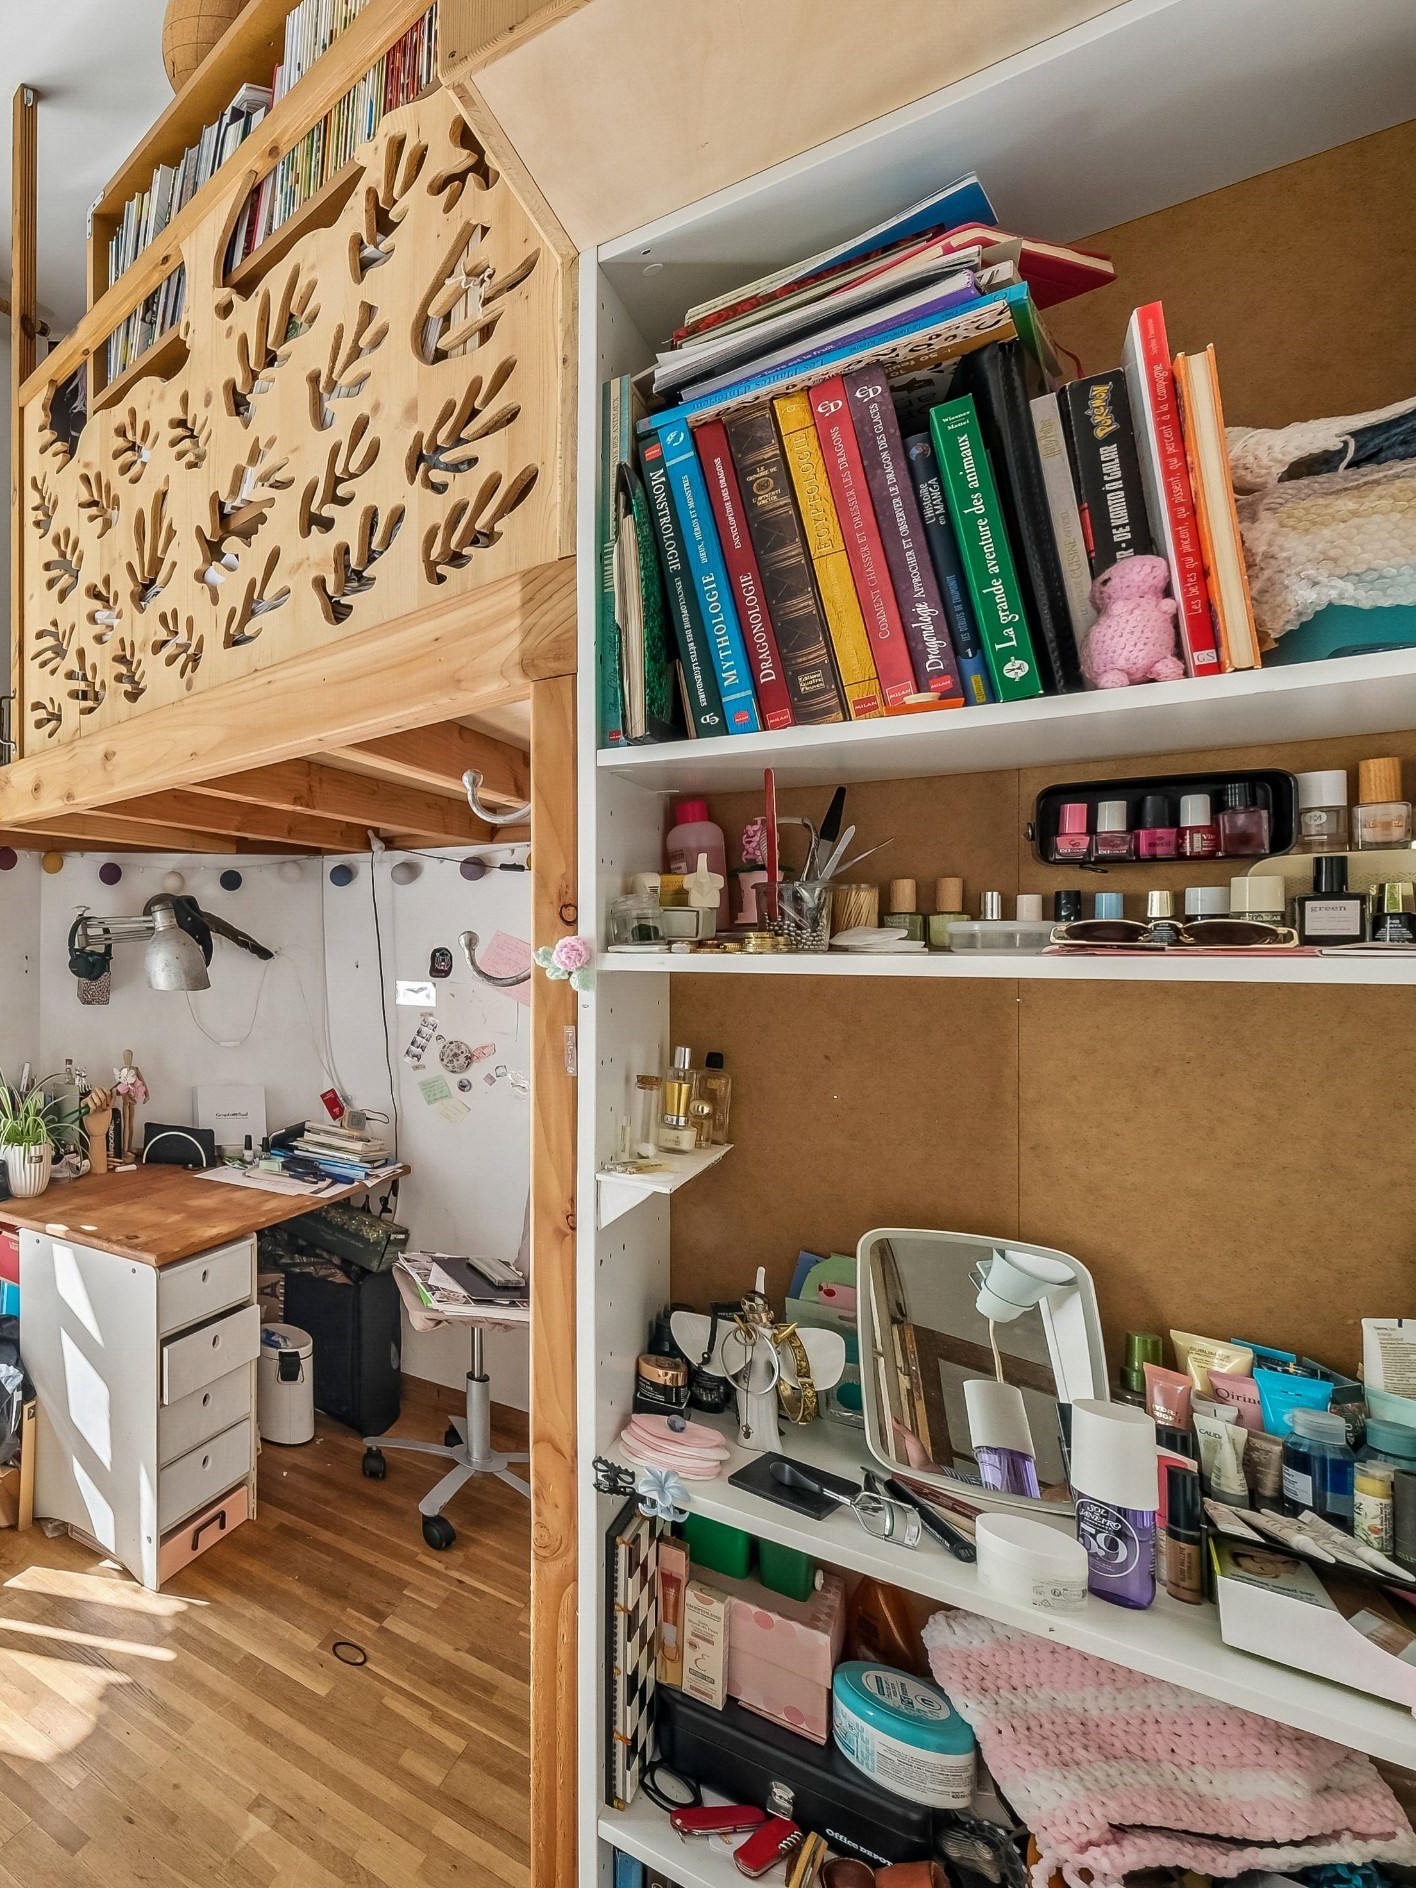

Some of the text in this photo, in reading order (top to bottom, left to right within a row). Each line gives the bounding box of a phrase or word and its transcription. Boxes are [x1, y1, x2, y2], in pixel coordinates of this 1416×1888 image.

[1150, 362, 1172, 401] campagne
[1155, 402, 1169, 413] la
[955, 433, 979, 490] animaux
[1097, 442, 1123, 481] GALAR
[1163, 455, 1181, 471] qui
[679, 473, 696, 509] MONSTRES
[927, 476, 946, 525] en MANGA
[962, 490, 986, 517] des
[648, 468, 681, 572] MONSTROLOGIE
[687, 508, 698, 519] ET
[1105, 489, 1130, 526] KANTO
[1171, 505, 1190, 520] qui
[828, 424, 890, 639] COMMENT CHASSER ET DRESSER LES DRAGONS
[867, 402, 944, 673] Dragonologie APPROCHER ET OBSERVER LE DRAGON DES GLACES
[1111, 524, 1132, 542] DE
[975, 517, 998, 574] aventure
[712, 455, 776, 683] DRAGONOLOGIE ENCYCLOPÉDIE DES DRAGONS
[1180, 554, 1198, 570] qui
[1181, 571, 1200, 597] bêtes
[984, 574, 1020, 626] grande
[1186, 598, 1203, 616] Les
[683, 628, 694, 643] DES
[701, 572, 739, 685] MYTHOLOGIE
[995, 626, 1017, 650] La
[686, 641, 700, 663] BÊTES
[854, 701, 878, 711] MILAN
[889, 688, 912, 699] MILAN
[769, 715, 789, 724] MILAN
[1079, 1509, 1122, 1531] JANEIRO
[1086, 1504, 1108, 1516] SOL
[823, 1826, 894, 1868] Office DEPOT
